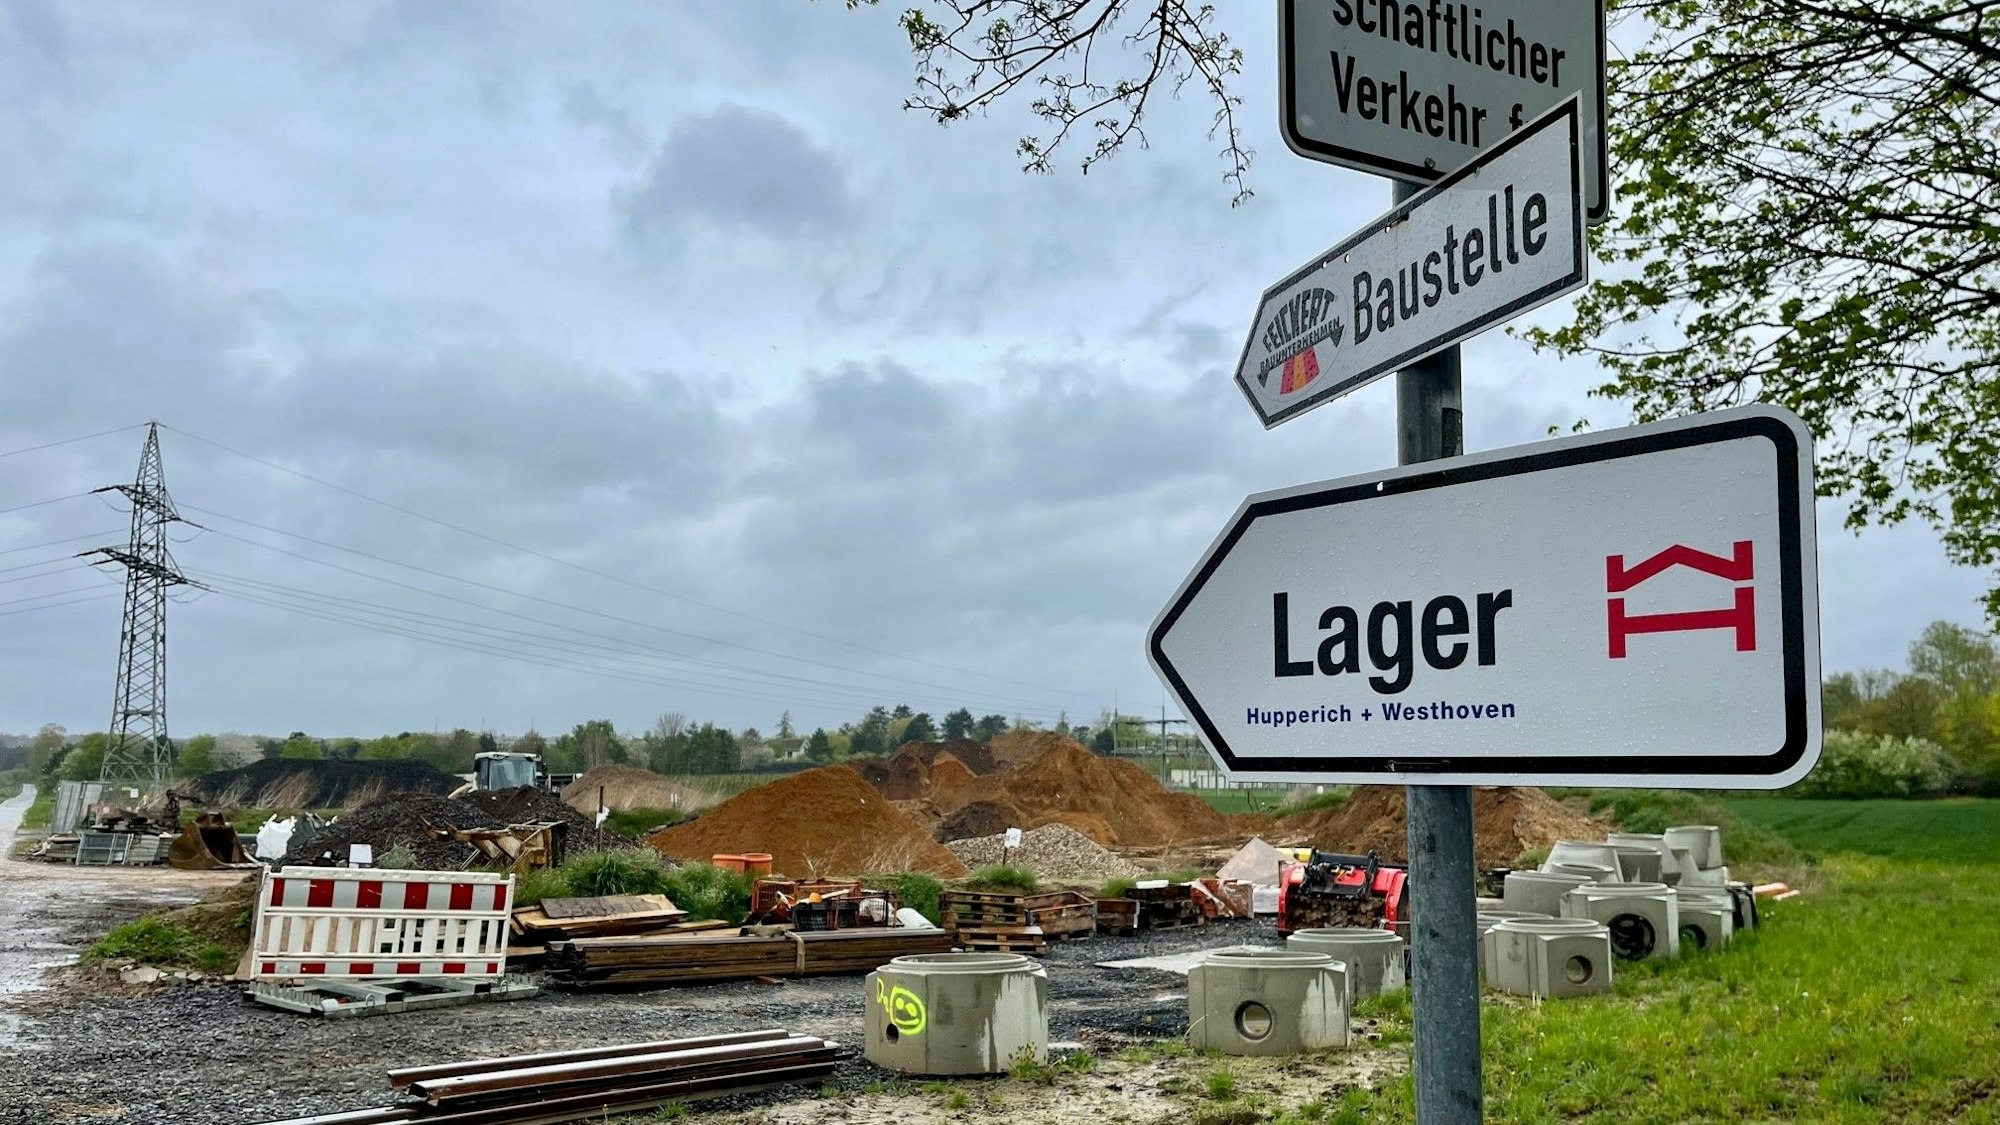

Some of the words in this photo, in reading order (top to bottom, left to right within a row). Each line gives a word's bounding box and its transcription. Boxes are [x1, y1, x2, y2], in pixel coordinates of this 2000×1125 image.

[1333, 0, 1566, 88] schaftlicher
[1330, 50, 1487, 148] Verkehr
[1353, 184, 1548, 345] Baustelle
[1262, 287, 1335, 353] FEICKERT
[1273, 588, 1513, 694] Lager
[1247, 705, 1351, 727] Hupperich
[1382, 700, 1516, 721] Westhoven
